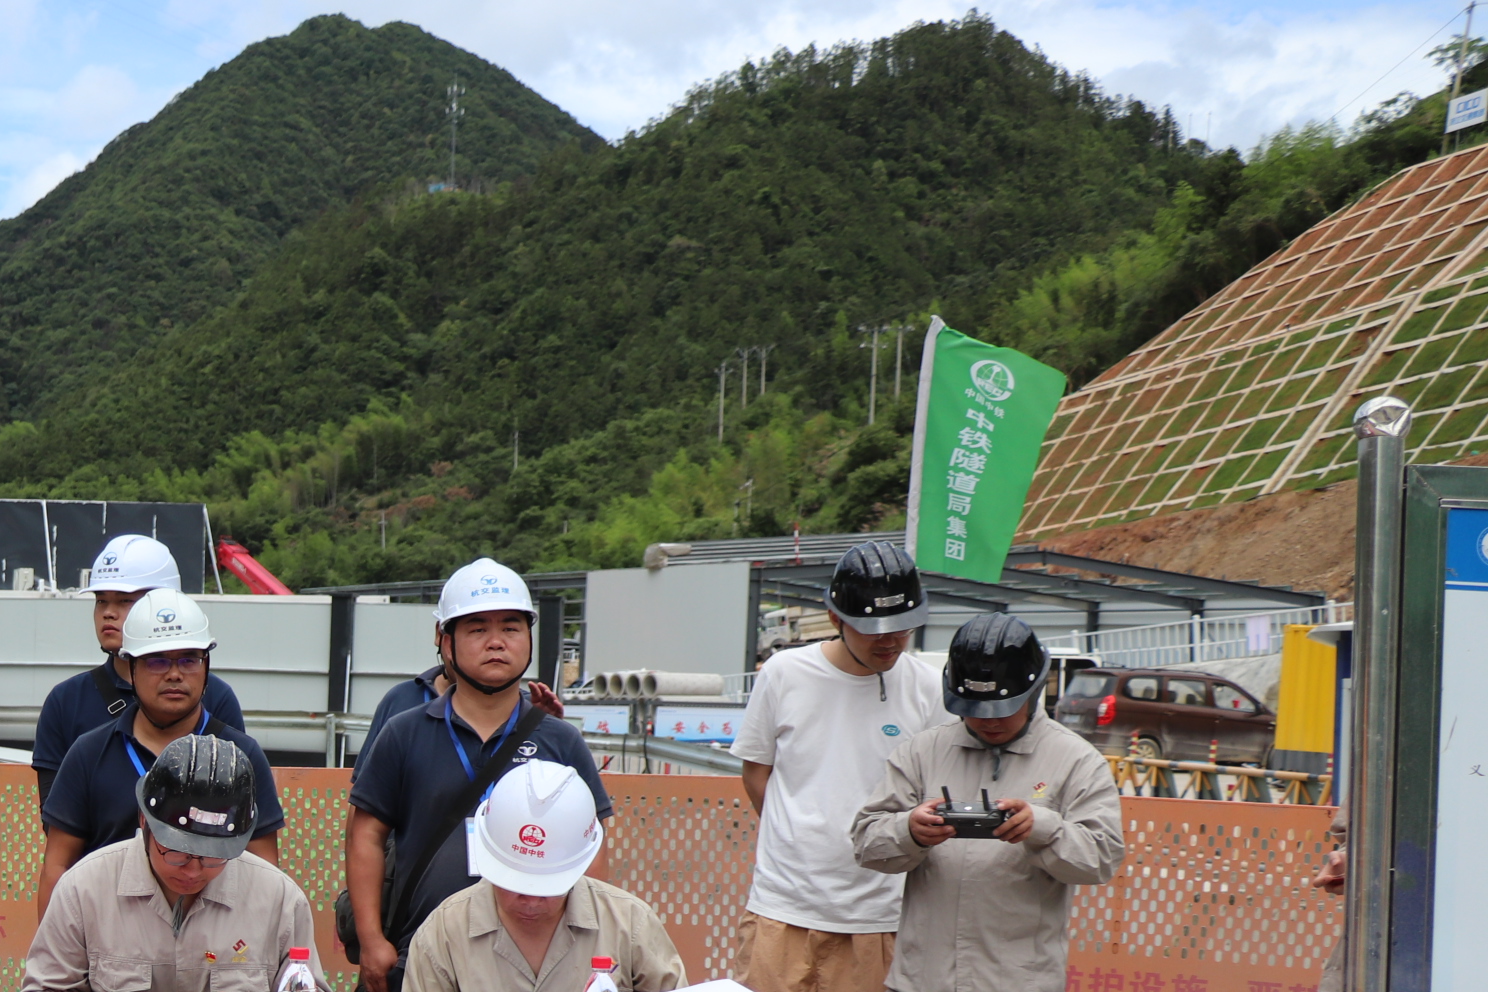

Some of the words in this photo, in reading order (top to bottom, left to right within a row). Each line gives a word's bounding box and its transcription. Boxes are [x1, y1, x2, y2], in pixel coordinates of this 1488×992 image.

[964, 388, 1005, 419] 中国中铁
[944, 408, 995, 561] 中铁隧道局集团
[511, 843, 546, 859] 中国中铁
